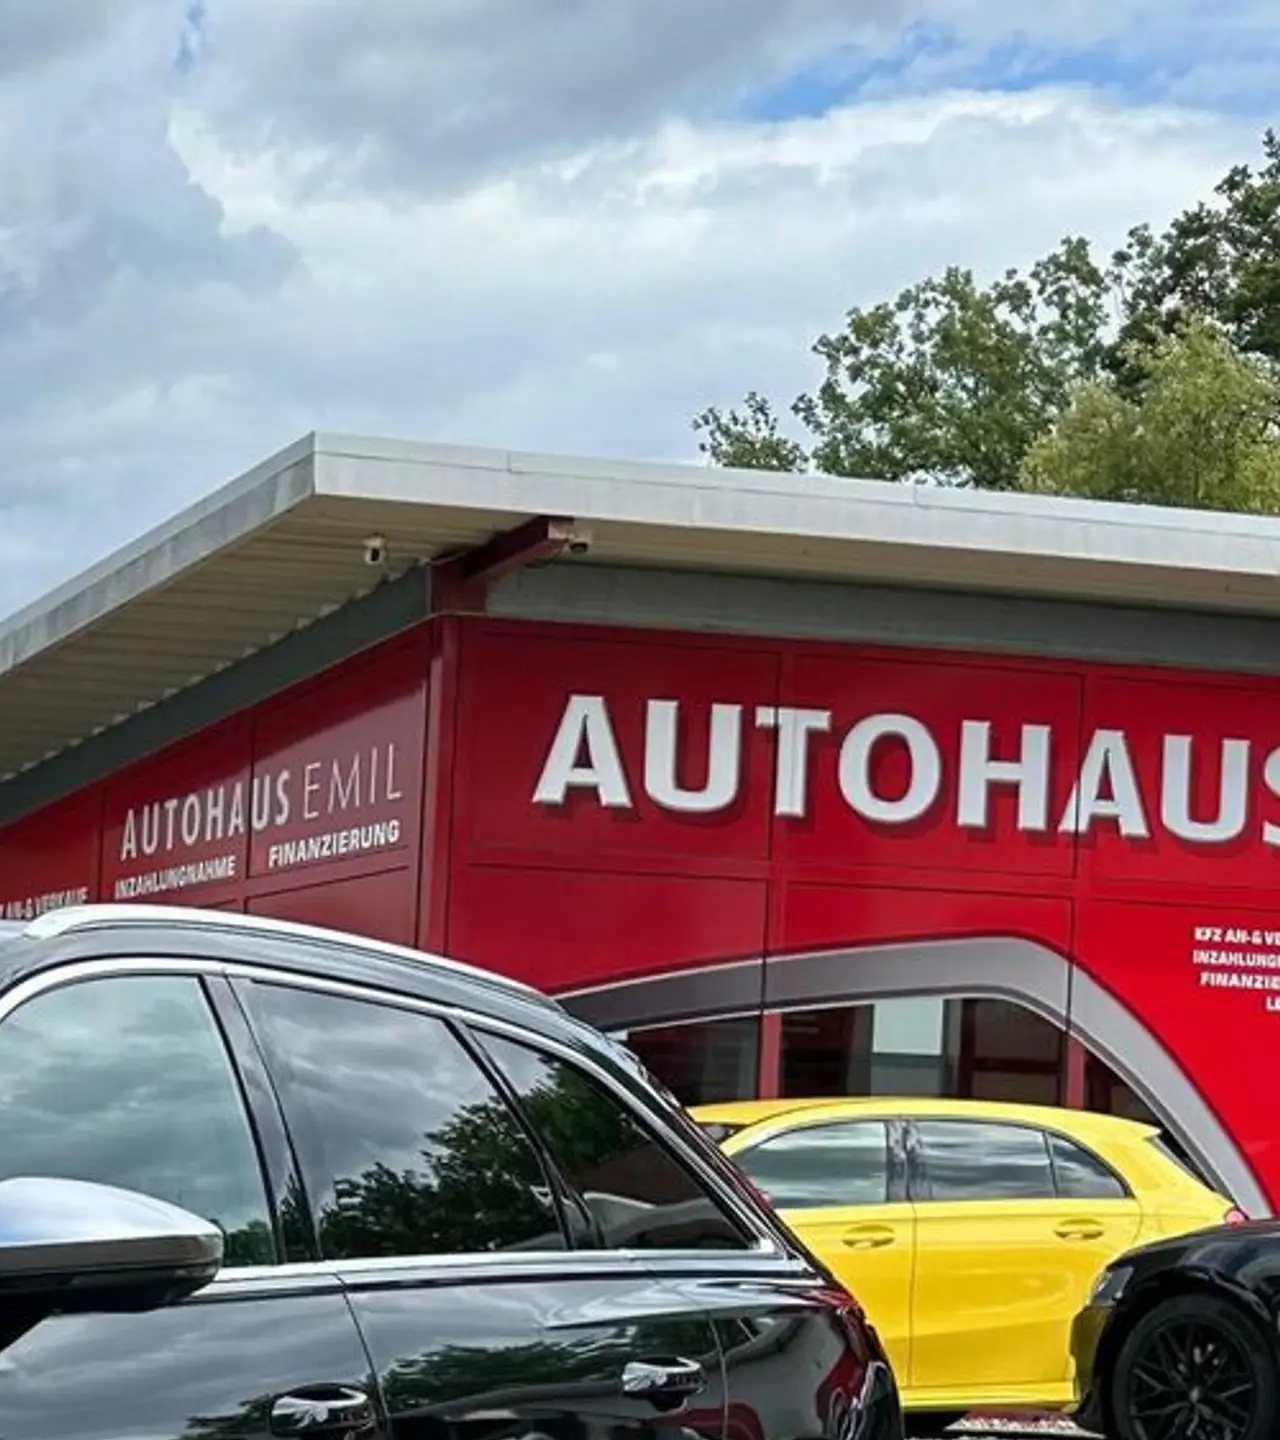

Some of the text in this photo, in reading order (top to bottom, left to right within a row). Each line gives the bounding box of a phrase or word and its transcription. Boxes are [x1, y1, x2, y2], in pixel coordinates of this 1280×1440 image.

[120, 743, 402, 862] AUTOHAUS EMIL
[531, 693, 1280, 845] AUTOHAU
[268, 819, 401, 869] FINANZIERUNG
[1192, 948, 1280, 969] INZAHLUNG
